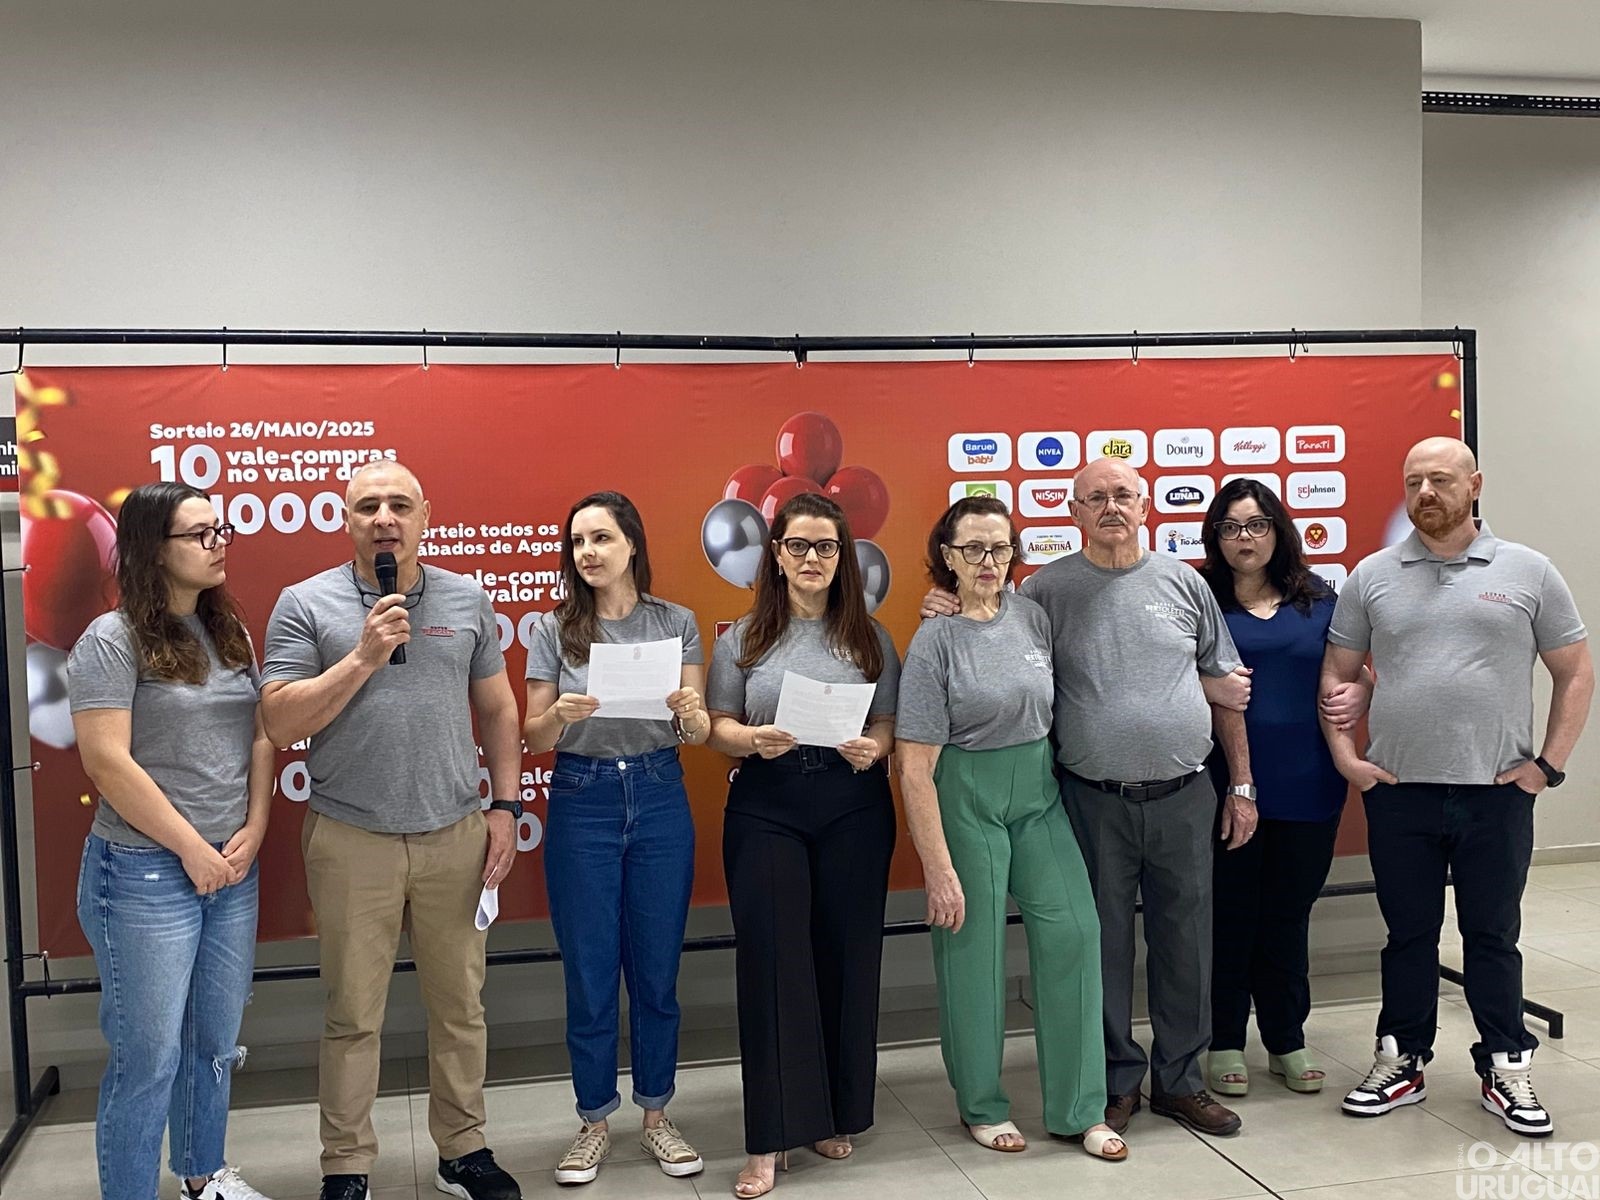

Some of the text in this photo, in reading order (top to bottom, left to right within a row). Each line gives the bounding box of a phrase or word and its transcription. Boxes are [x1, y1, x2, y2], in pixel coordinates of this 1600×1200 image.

[150, 421, 375, 440] Sorteio 26/MAIO/2025
[965, 443, 995, 451] Baruel
[1102, 440, 1132, 455] clara
[1166, 444, 1204, 458] Downy
[1233, 441, 1267, 453] Kellogg's
[226, 446, 397, 467] vale-compras
[967, 455, 993, 465] baby
[151, 444, 221, 489] 10
[227, 467, 258, 482] no
[265, 464, 329, 482] valor
[1035, 490, 1065, 502] NISSIN
[421, 522, 559, 539] orteio todos os
[417, 539, 562, 556] ábados de Agos
[1028, 541, 1072, 551] ARGENTINA
[1180, 538, 1190, 546] Tio
[485, 580, 568, 602] valor d
